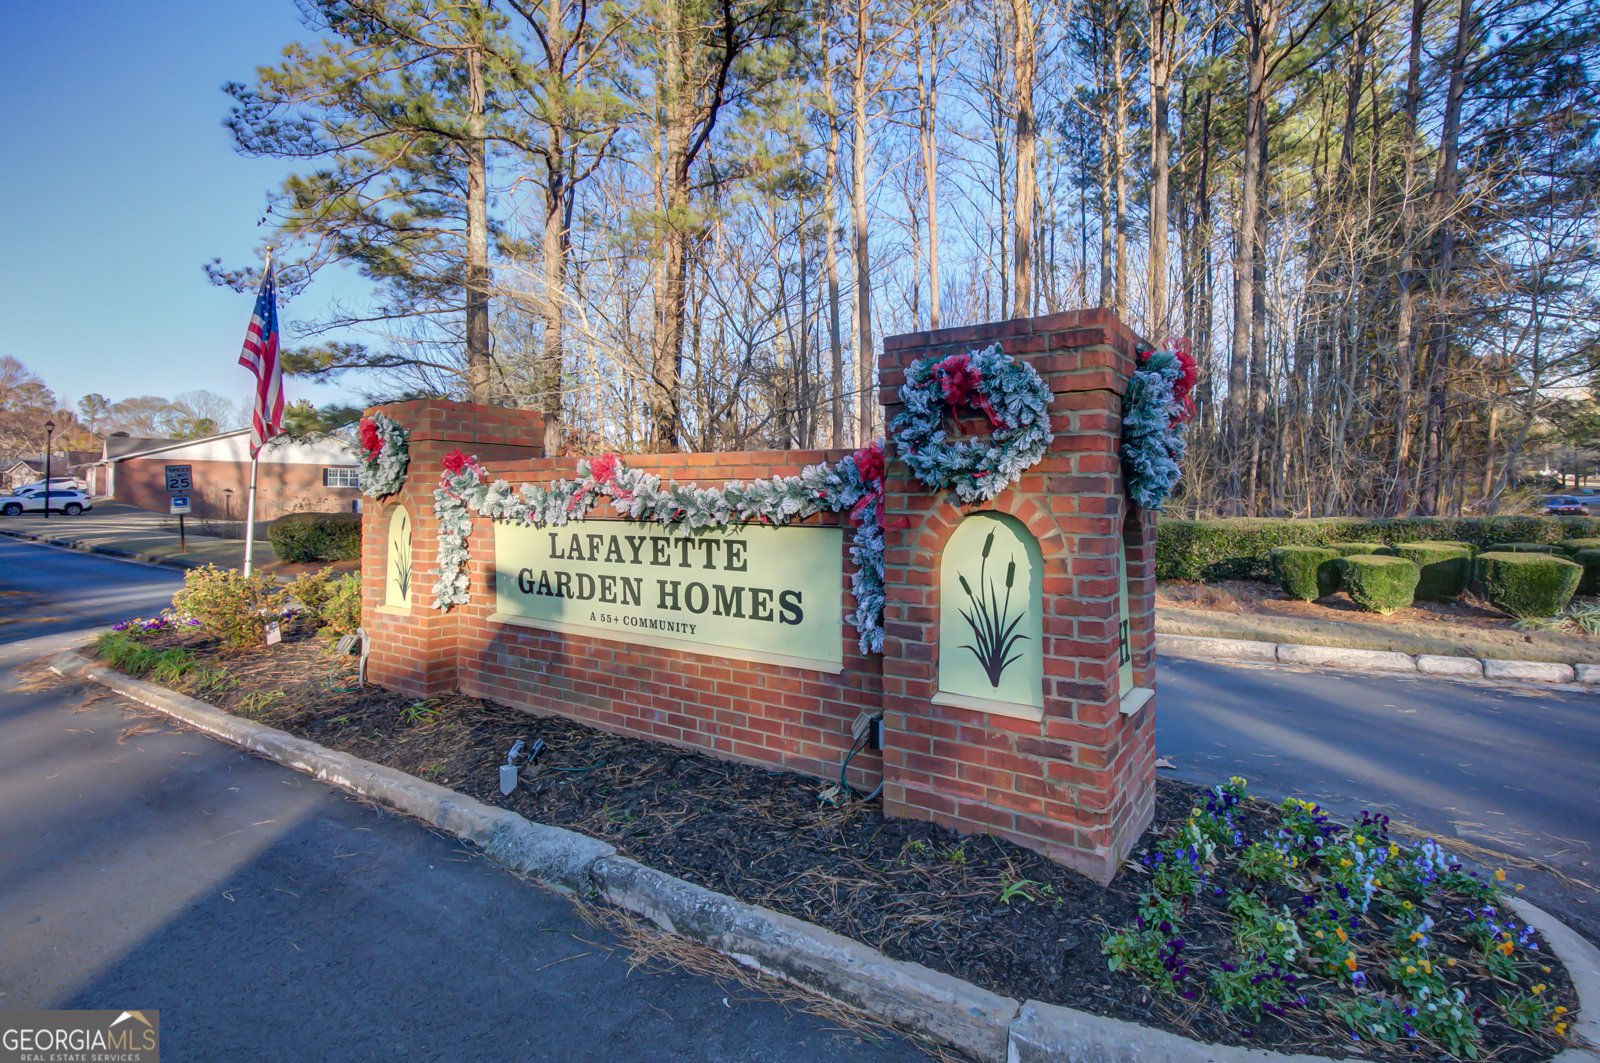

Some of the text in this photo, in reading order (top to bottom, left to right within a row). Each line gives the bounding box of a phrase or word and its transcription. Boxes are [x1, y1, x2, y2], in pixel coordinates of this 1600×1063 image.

[170, 478, 190, 489] 25
[548, 532, 748, 572] LAFAYETTE
[518, 567, 804, 625] GARDEN HOMES
[590, 611, 697, 635] A 55+ COMMUNITY
